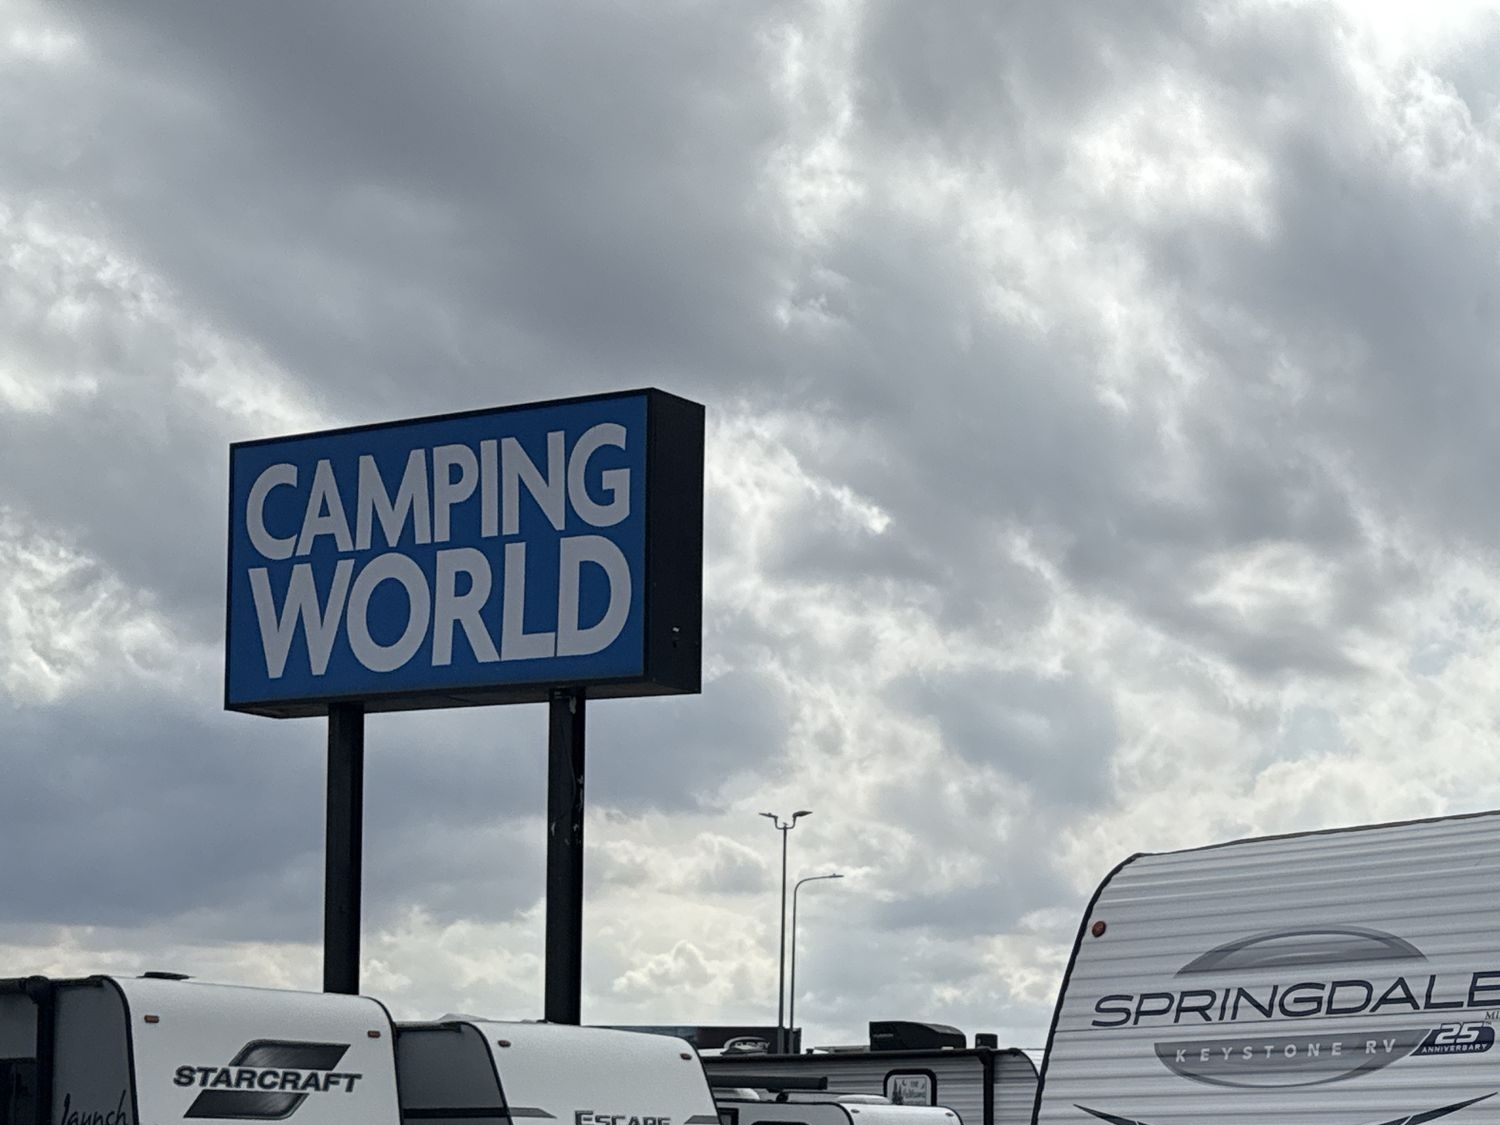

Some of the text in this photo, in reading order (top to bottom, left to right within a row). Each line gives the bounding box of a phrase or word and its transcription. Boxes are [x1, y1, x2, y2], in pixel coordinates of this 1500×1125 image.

[246, 422, 631, 560] CAMPING
[248, 534, 632, 679] WORLD
[1434, 1021, 1483, 1045] 25
[1176, 1038, 1397, 1063] KEYSTONE RV
[1421, 1043, 1488, 1054] ANNIVERSARY
[173, 1065, 363, 1093] STARCRAFT
